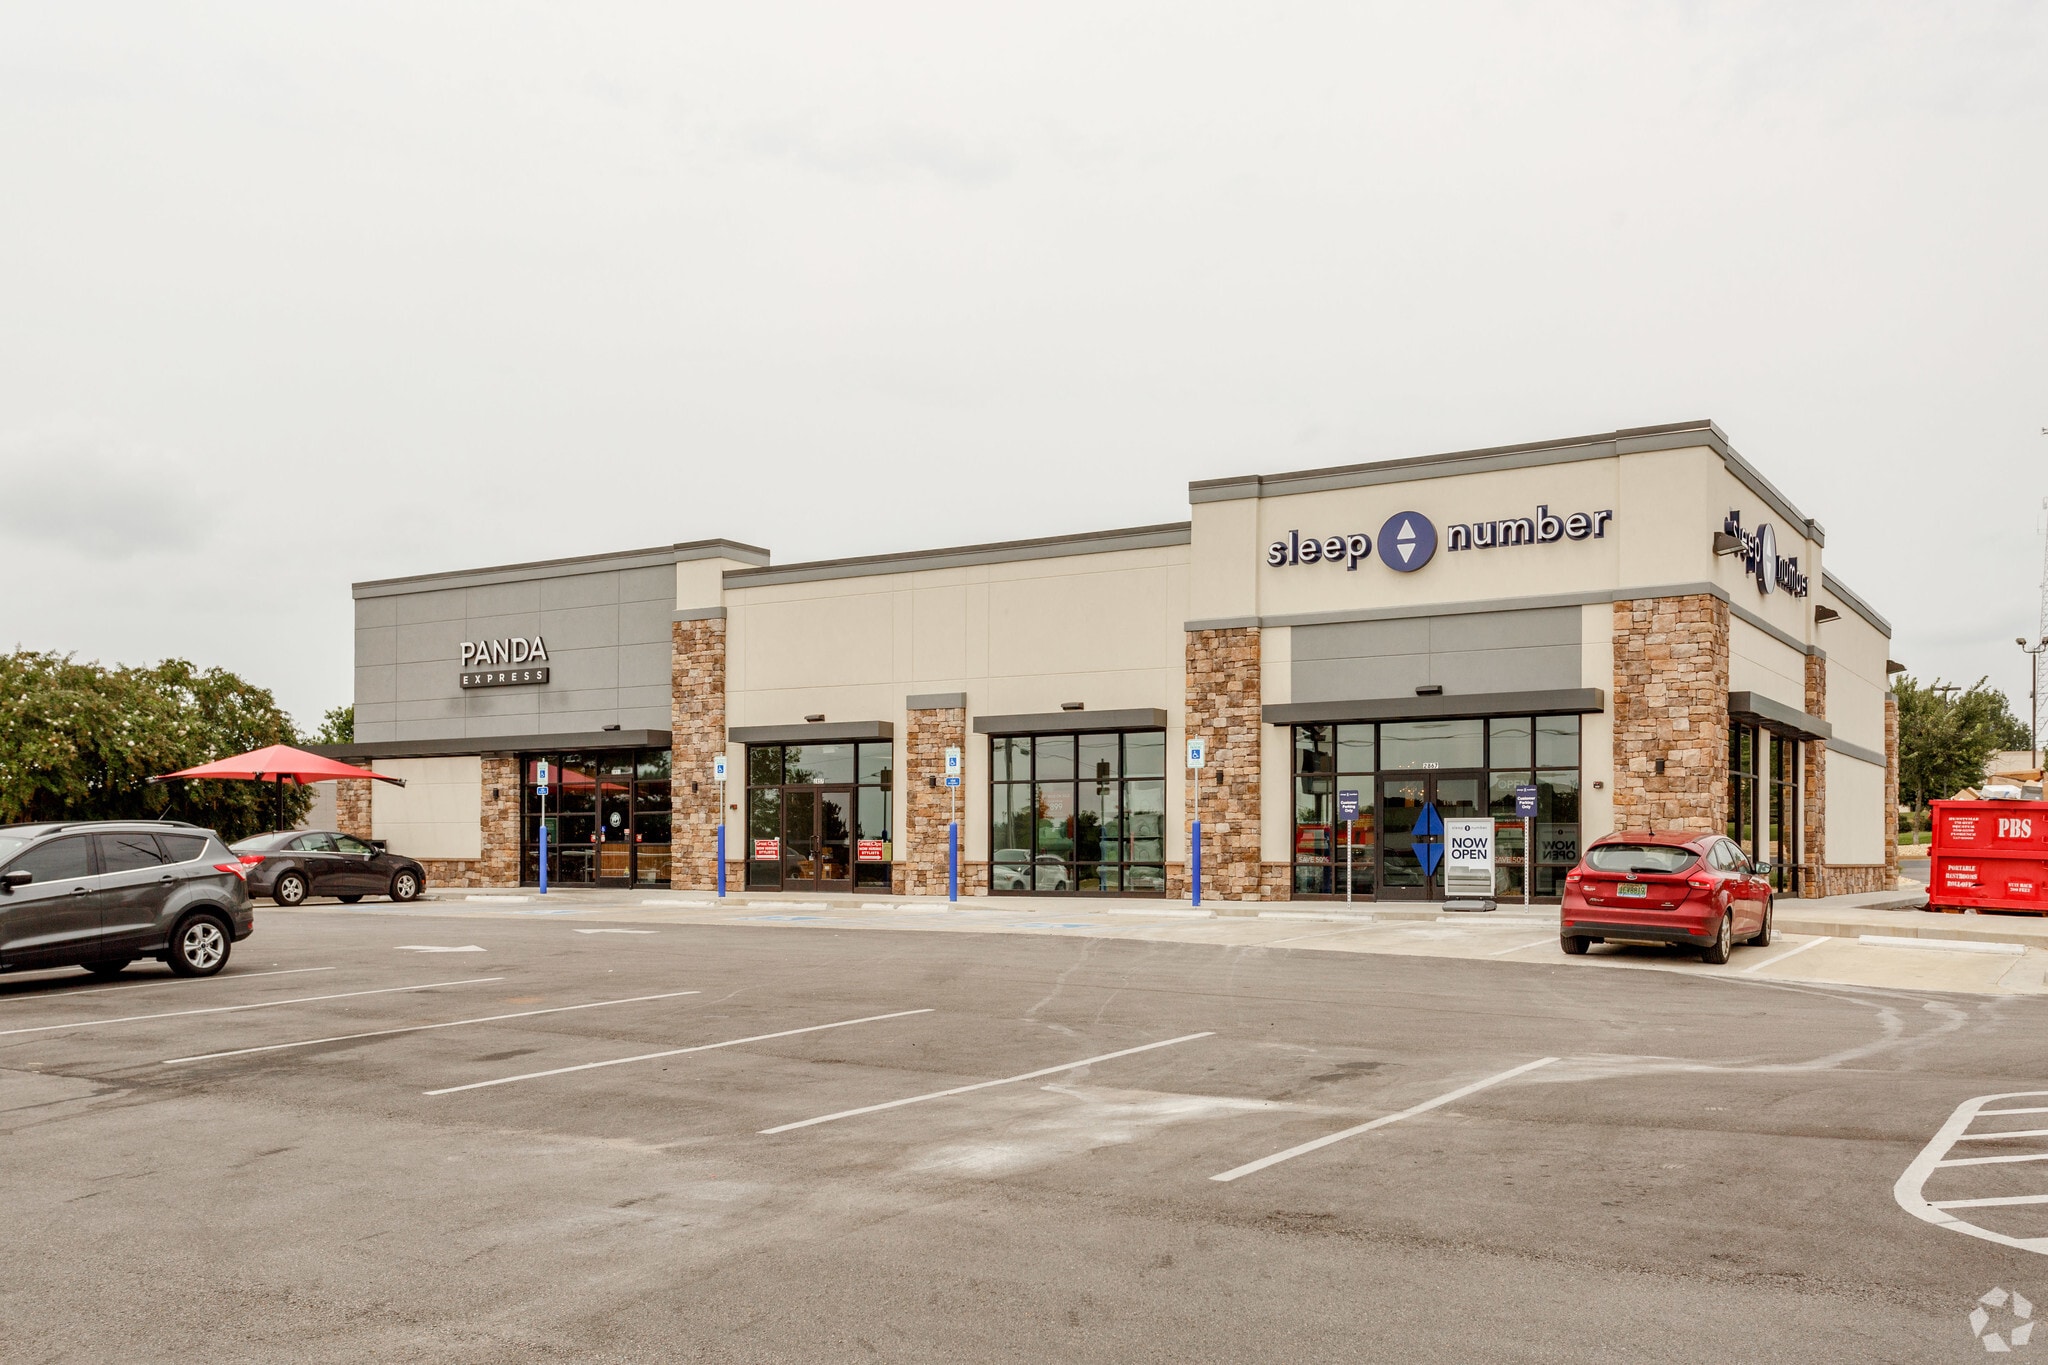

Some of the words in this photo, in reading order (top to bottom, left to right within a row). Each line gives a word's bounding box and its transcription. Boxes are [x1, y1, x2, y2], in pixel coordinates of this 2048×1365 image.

[1267, 530, 1372, 571] sleep
[1448, 505, 1612, 551] number
[460, 636, 549, 666] PANDA
[463, 671, 542, 685] EXPRESS
[1998, 818, 2031, 838] PBS
[1452, 837, 1488, 849] NOW
[1452, 849, 1487, 860] OPEN
